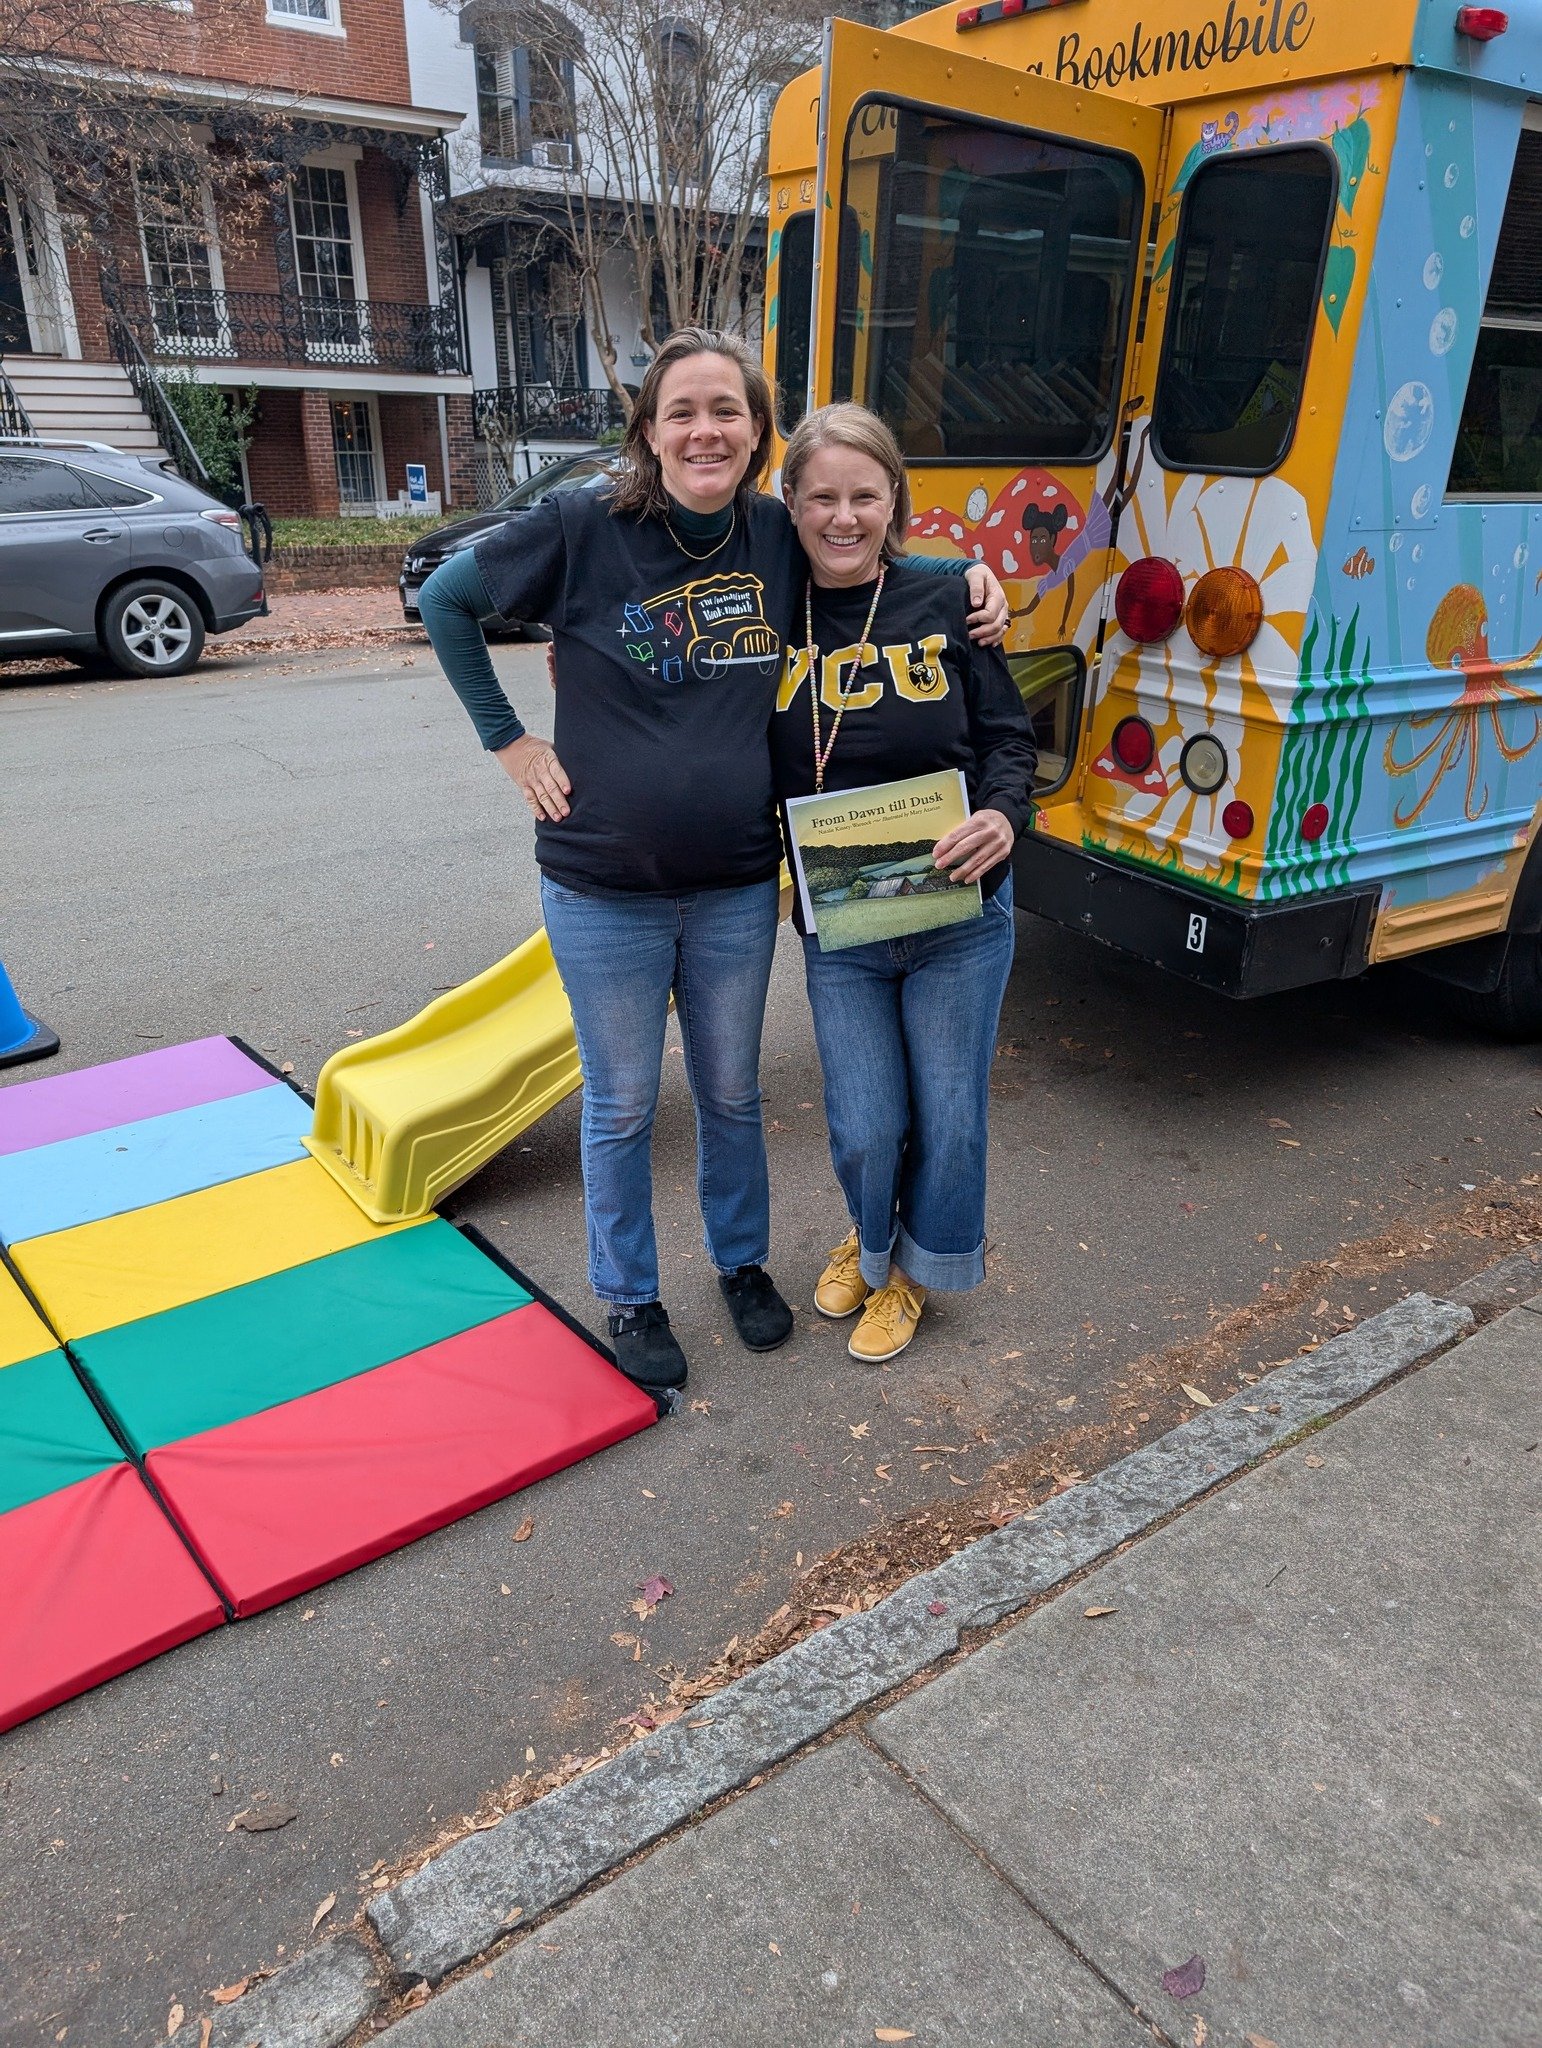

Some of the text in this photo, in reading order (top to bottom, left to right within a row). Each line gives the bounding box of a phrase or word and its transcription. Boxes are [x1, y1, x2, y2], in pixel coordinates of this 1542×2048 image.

[1055, 0, 1316, 90] Bookmobile
[776, 634, 950, 712] VCU
[812, 792, 944, 828] From Dawn till Dusk
[882, 813, 904, 822] Illustrated
[909, 808, 923, 816] Mary
[1190, 916, 1203, 950] 3
